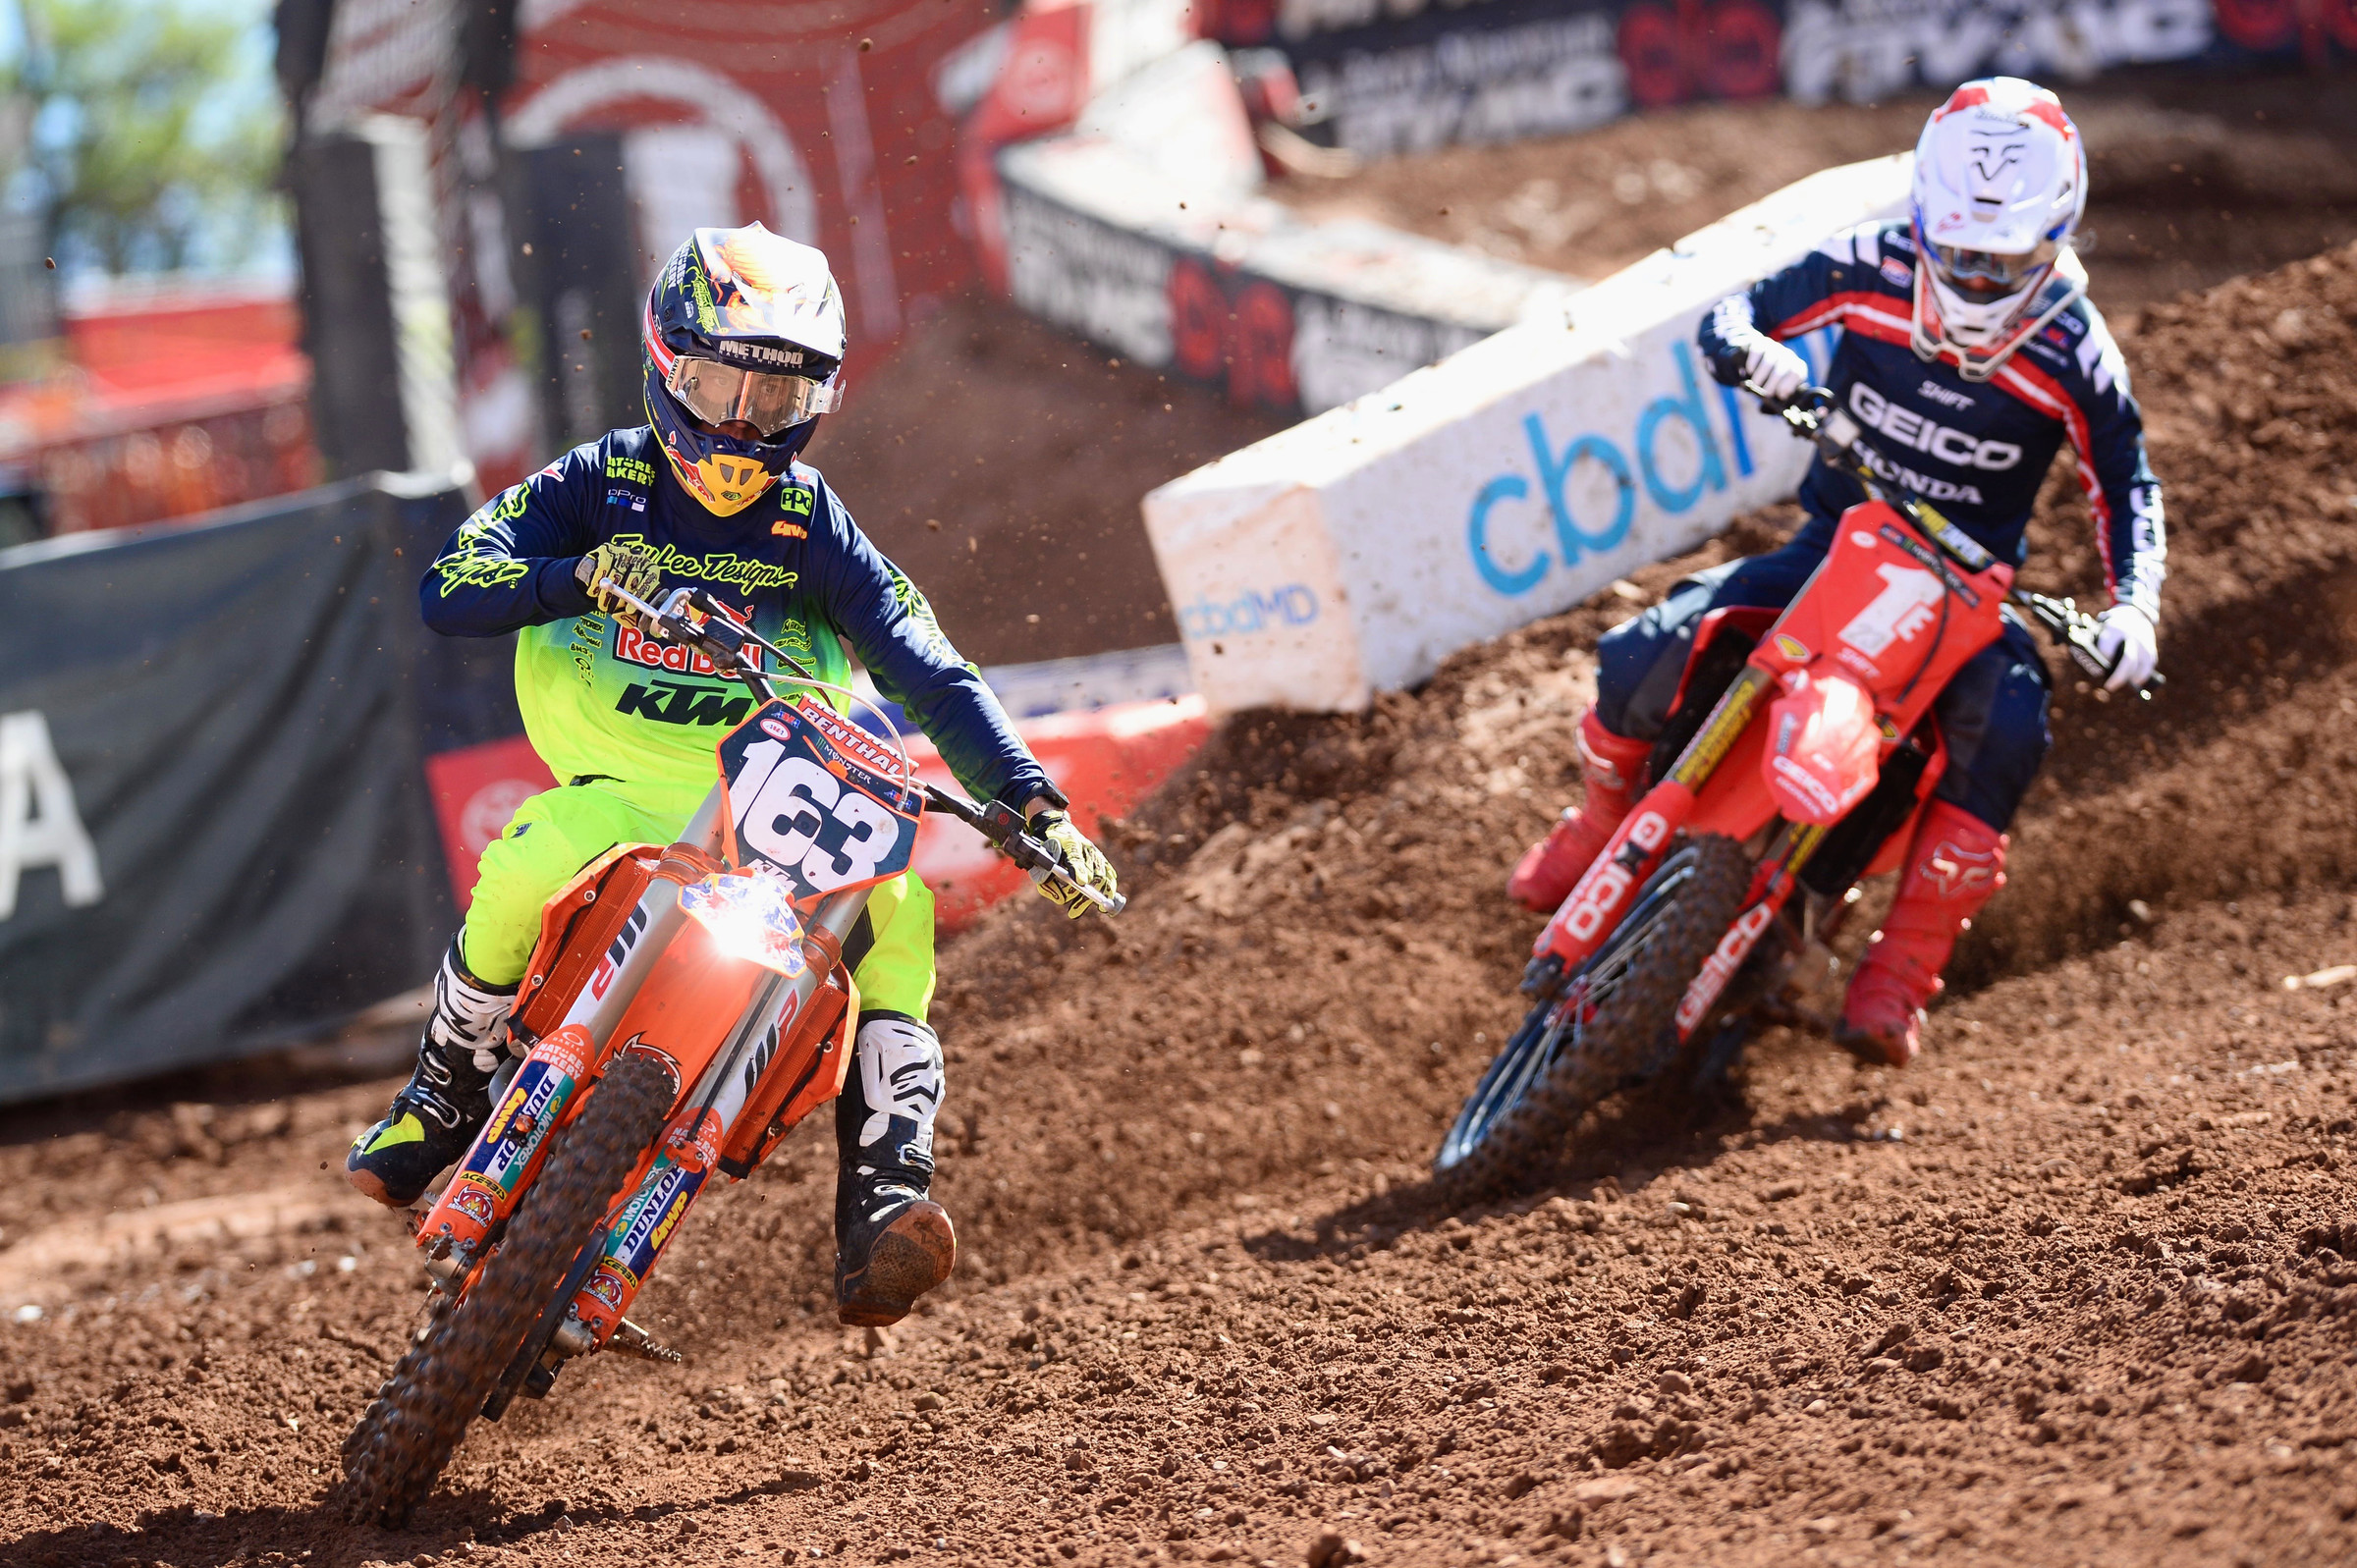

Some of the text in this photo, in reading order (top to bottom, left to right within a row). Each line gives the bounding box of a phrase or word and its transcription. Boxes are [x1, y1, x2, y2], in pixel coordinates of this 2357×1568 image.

[668, 358, 680, 387] OAKLEY
[719, 340, 803, 365] METHOD
[719, 350, 747, 360] RACE
[1917, 380, 1976, 411] SHIFT
[1848, 381, 2022, 470] GEICO
[1465, 324, 1842, 595] cbd
[1853, 439, 1984, 505] HONDA
[782, 489, 811, 512] PPG
[655, 543, 703, 577] Lee
[701, 554, 798, 596] Designs
[616, 625, 686, 672] Red
[615, 679, 754, 726] KTM
[801, 707, 903, 776] RENTHAL
[824, 743, 872, 784] MONSTER
[729, 738, 900, 892] 163
[1565, 810, 1669, 942] GICO
[532, 1051, 581, 1080] BAKERY
[497, 1075, 556, 1171] DUNOP
[513, 1110, 554, 1171] MOTOREX
[460, 1172, 505, 1200] ACERBIS
[621, 1163, 665, 1222] MOTOEX
[604, 1259, 636, 1288] CERBIS
